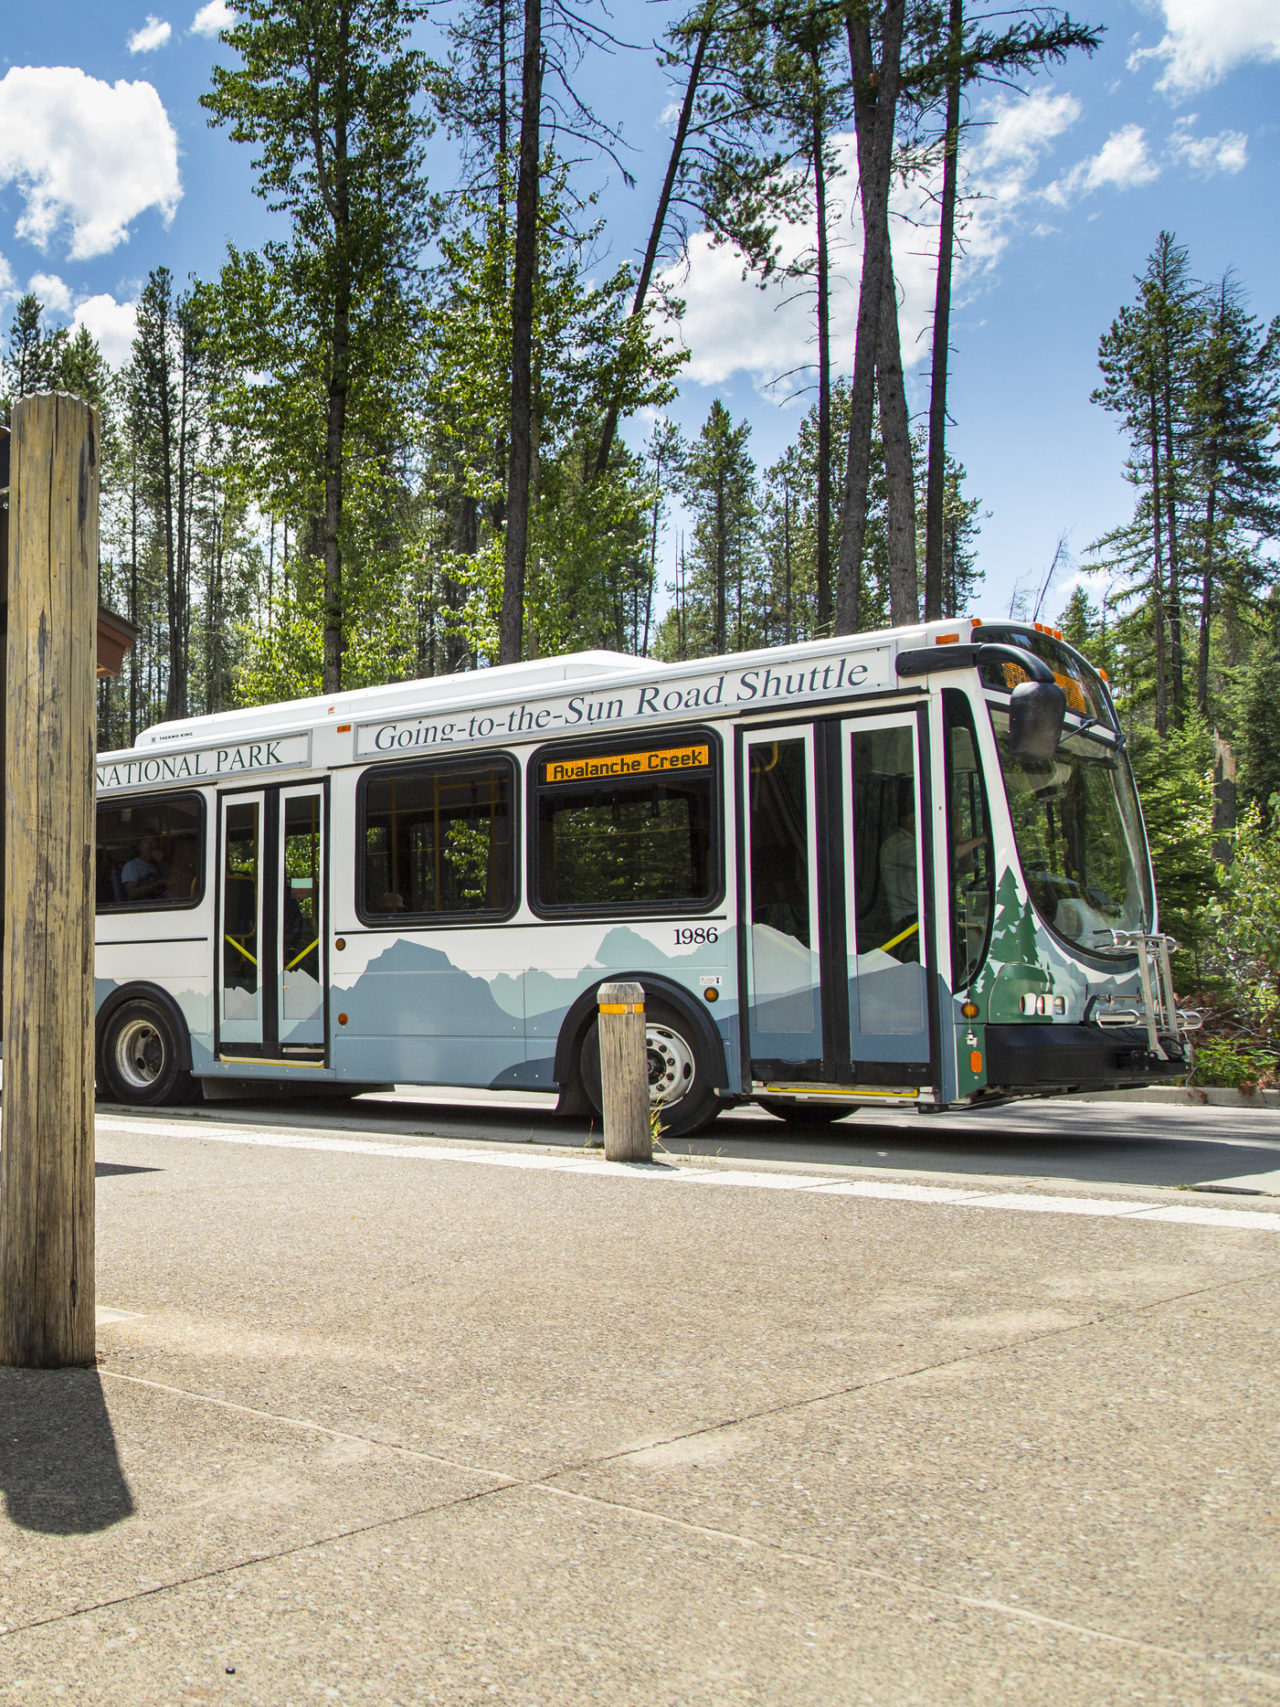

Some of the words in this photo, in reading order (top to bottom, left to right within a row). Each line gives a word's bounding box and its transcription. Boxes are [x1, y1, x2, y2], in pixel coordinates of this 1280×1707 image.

[374, 696, 624, 750] Going-to-the-Sun
[636, 676, 725, 714] Road
[736, 658, 869, 702] Shuttle
[216, 740, 283, 772] PARK
[553, 758, 641, 779] Avalanche
[647, 750, 702, 770] Creek
[673, 927, 718, 945] 1986
